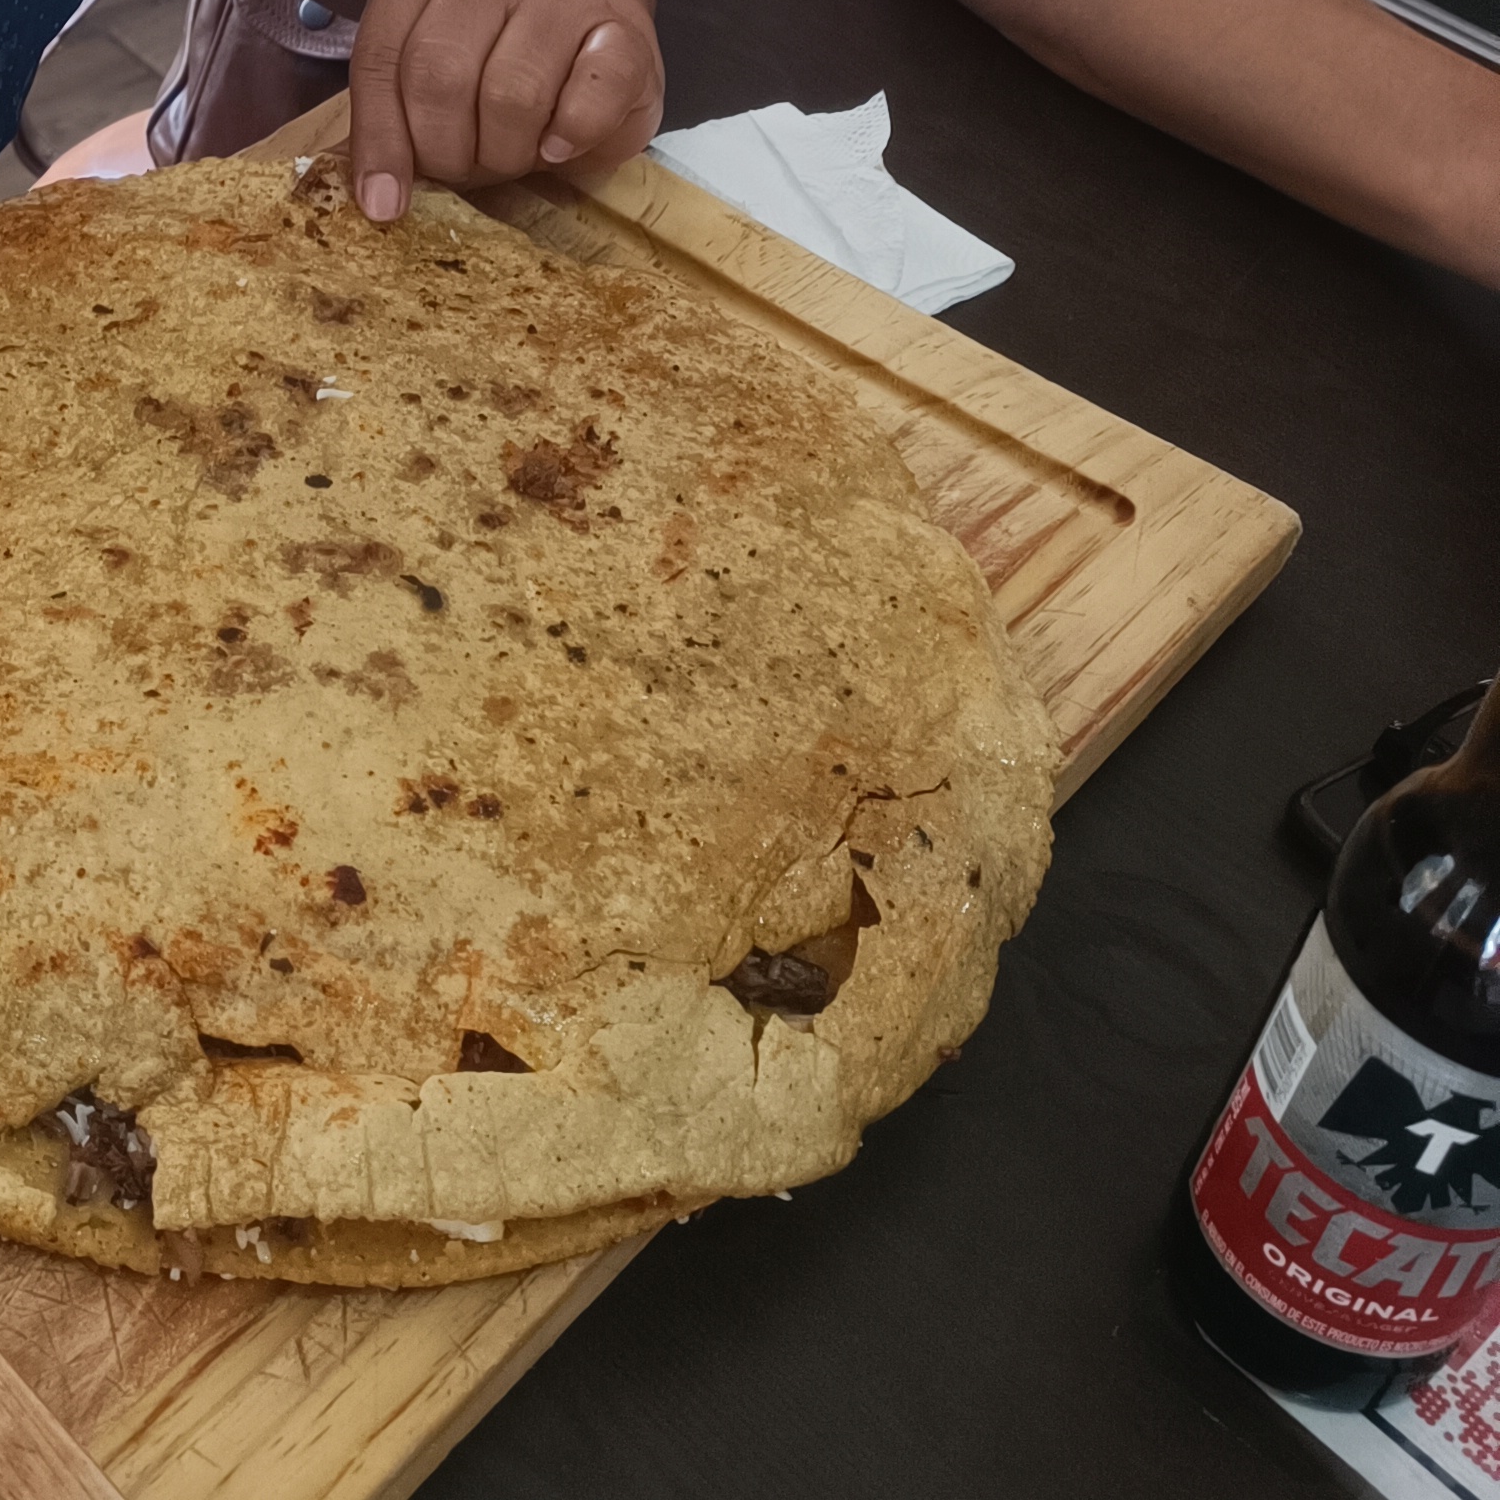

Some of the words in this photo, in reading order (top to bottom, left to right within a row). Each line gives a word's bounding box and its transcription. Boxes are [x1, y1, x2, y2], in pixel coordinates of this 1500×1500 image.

[1404, 1118, 1480, 1176] T
[1244, 1273, 1288, 1313] CONSUMO
[1286, 1307, 1303, 1323] DE
[1301, 1315, 1328, 1336] ESTE
[1326, 1326, 1381, 1352] PRODUCTO
[1262, 1242, 1440, 1322] ORIGINAL
